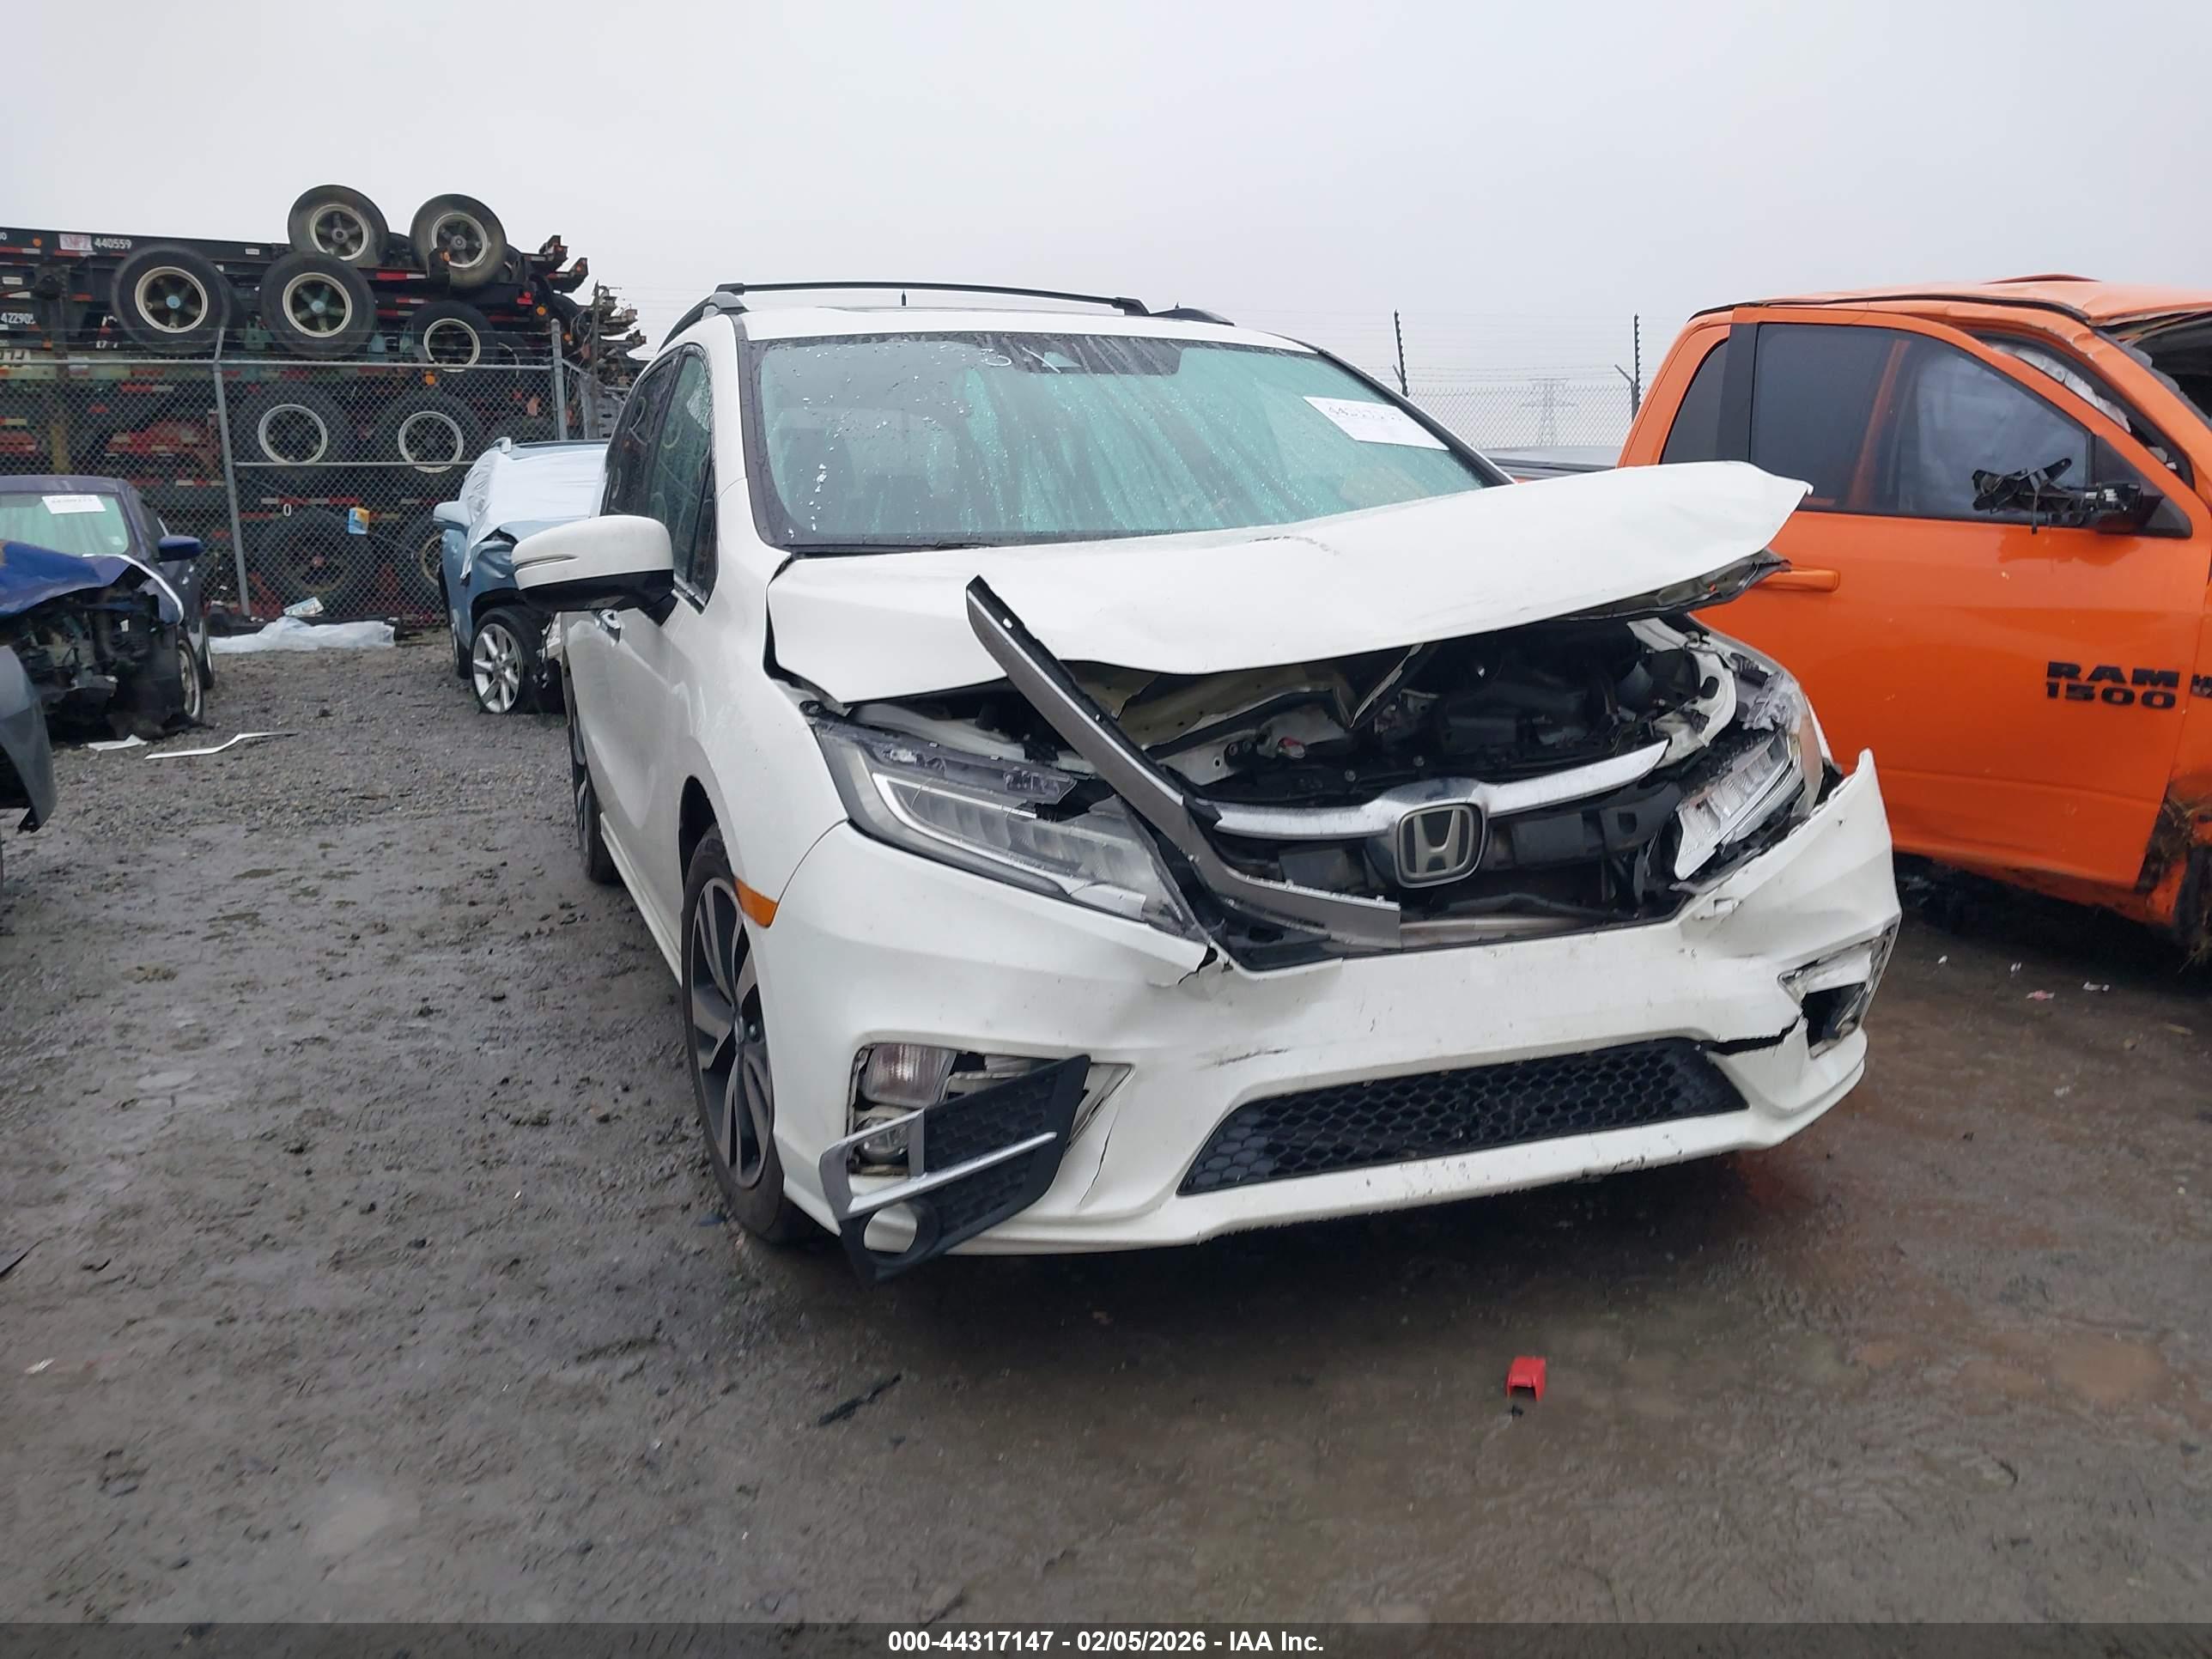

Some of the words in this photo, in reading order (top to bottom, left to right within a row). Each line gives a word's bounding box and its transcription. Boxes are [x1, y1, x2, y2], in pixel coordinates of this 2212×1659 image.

[94, 238, 132, 250] 440559
[2046, 660, 2180, 689] RAM
[2046, 681, 2176, 709] 1500
